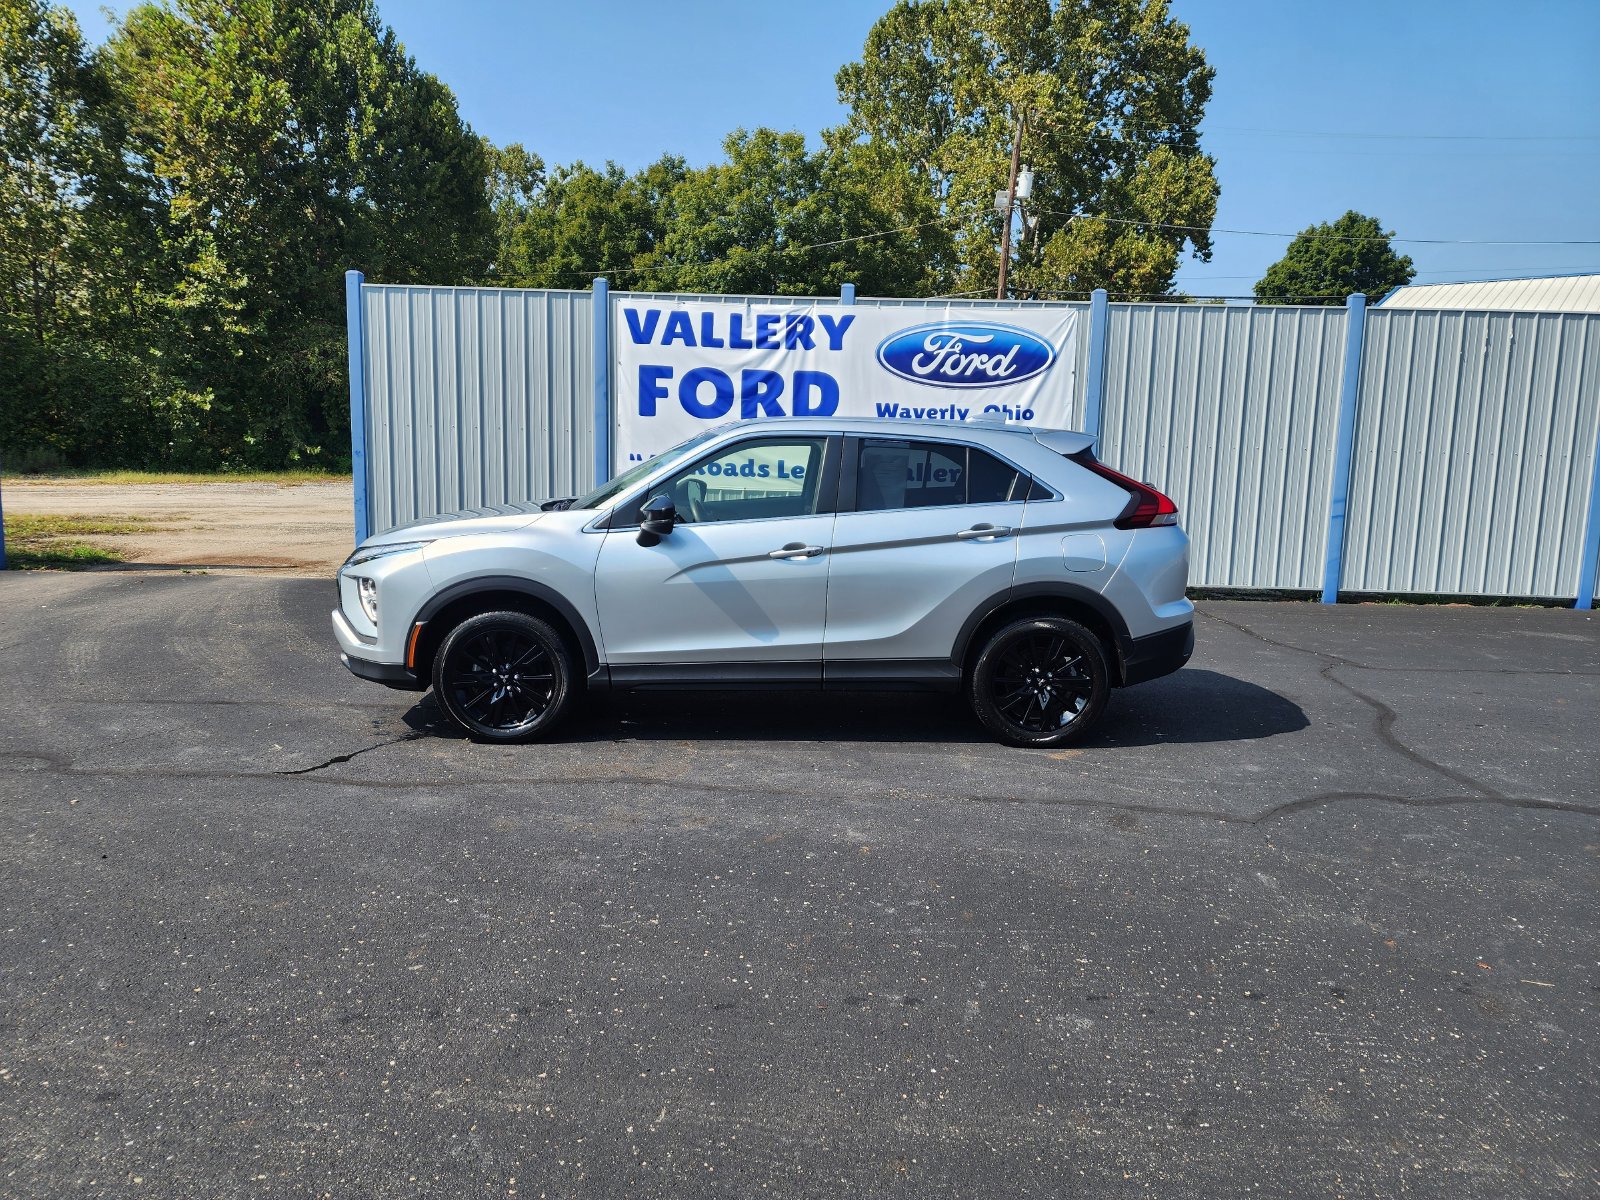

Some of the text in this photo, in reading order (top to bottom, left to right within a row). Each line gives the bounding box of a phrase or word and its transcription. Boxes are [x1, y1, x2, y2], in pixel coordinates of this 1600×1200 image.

[623, 308, 856, 351] VALLERY
[911, 331, 1021, 377] Ford
[638, 364, 840, 419] FORD
[875, 402, 970, 421] Waverly
